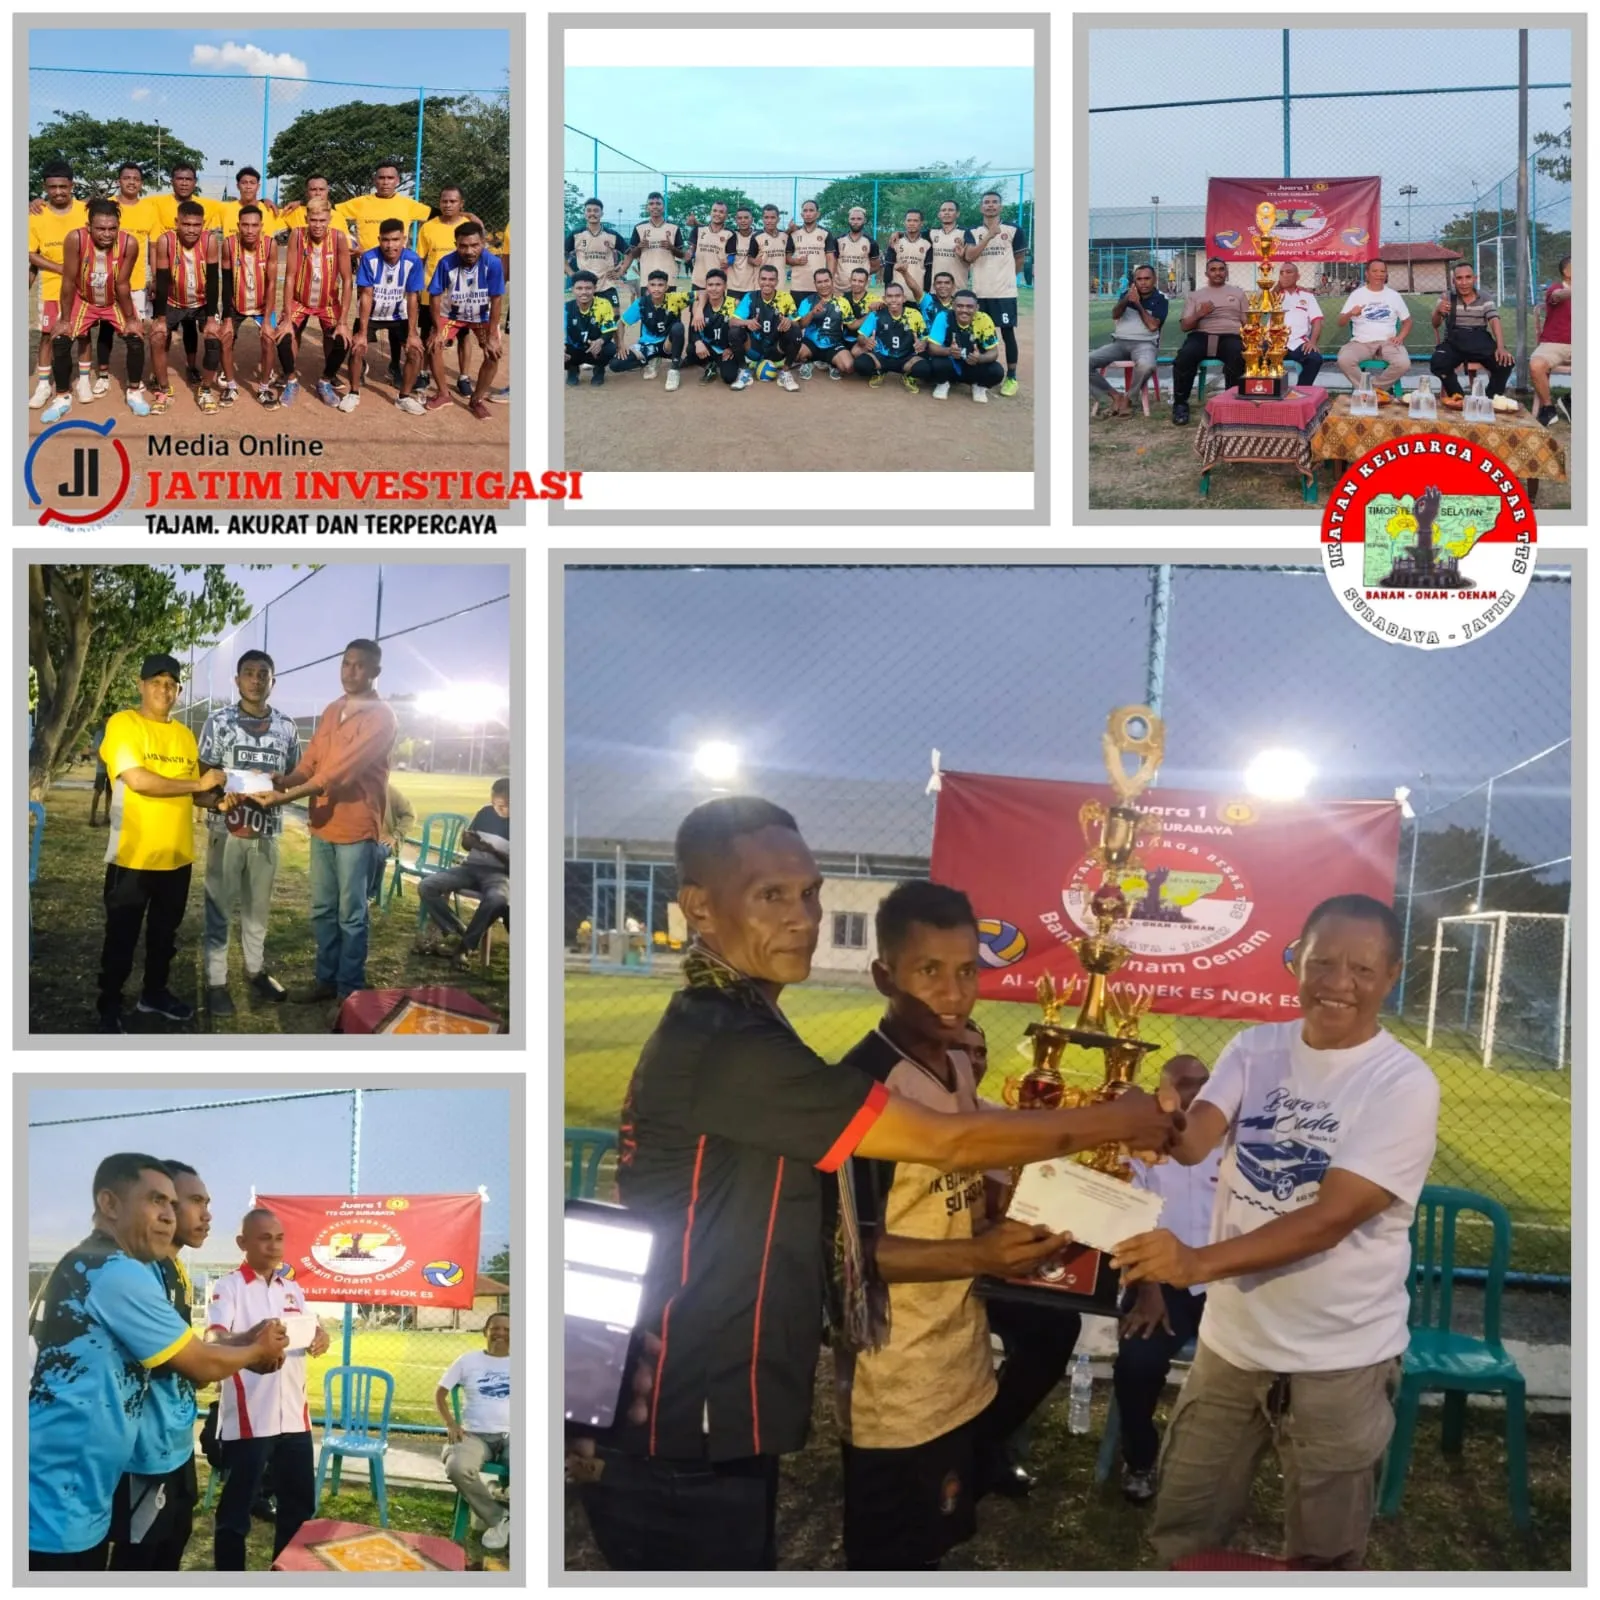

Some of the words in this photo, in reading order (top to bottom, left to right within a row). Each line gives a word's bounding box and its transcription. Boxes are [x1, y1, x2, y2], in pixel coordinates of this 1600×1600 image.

[823, 316, 831, 329] 2
[1002, 312, 1009, 324] 6
[656, 321, 666, 333] 5
[763, 320, 771, 333] 8
[580, 331, 589, 343] 7
[713, 327, 721, 340] 11
[892, 335, 900, 348] 9
[240, 751, 259, 761] ONE
[262, 752, 281, 764] WAY
[1134, 805, 1192, 818] uara
[1198, 805, 1208, 819] 1
[1158, 822, 1233, 836] URABAYA
[1039, 911, 1073, 944] Ban
[1192, 929, 1272, 970] Oenam
[1191, 986, 1216, 1000] ES
[1223, 989, 1273, 1006] NOK
[1279, 994, 1301, 1008] ES
[339, 1201, 372, 1209] Juara
[333, 1275, 373, 1285] Onam
[375, 1259, 416, 1281] Oenam
